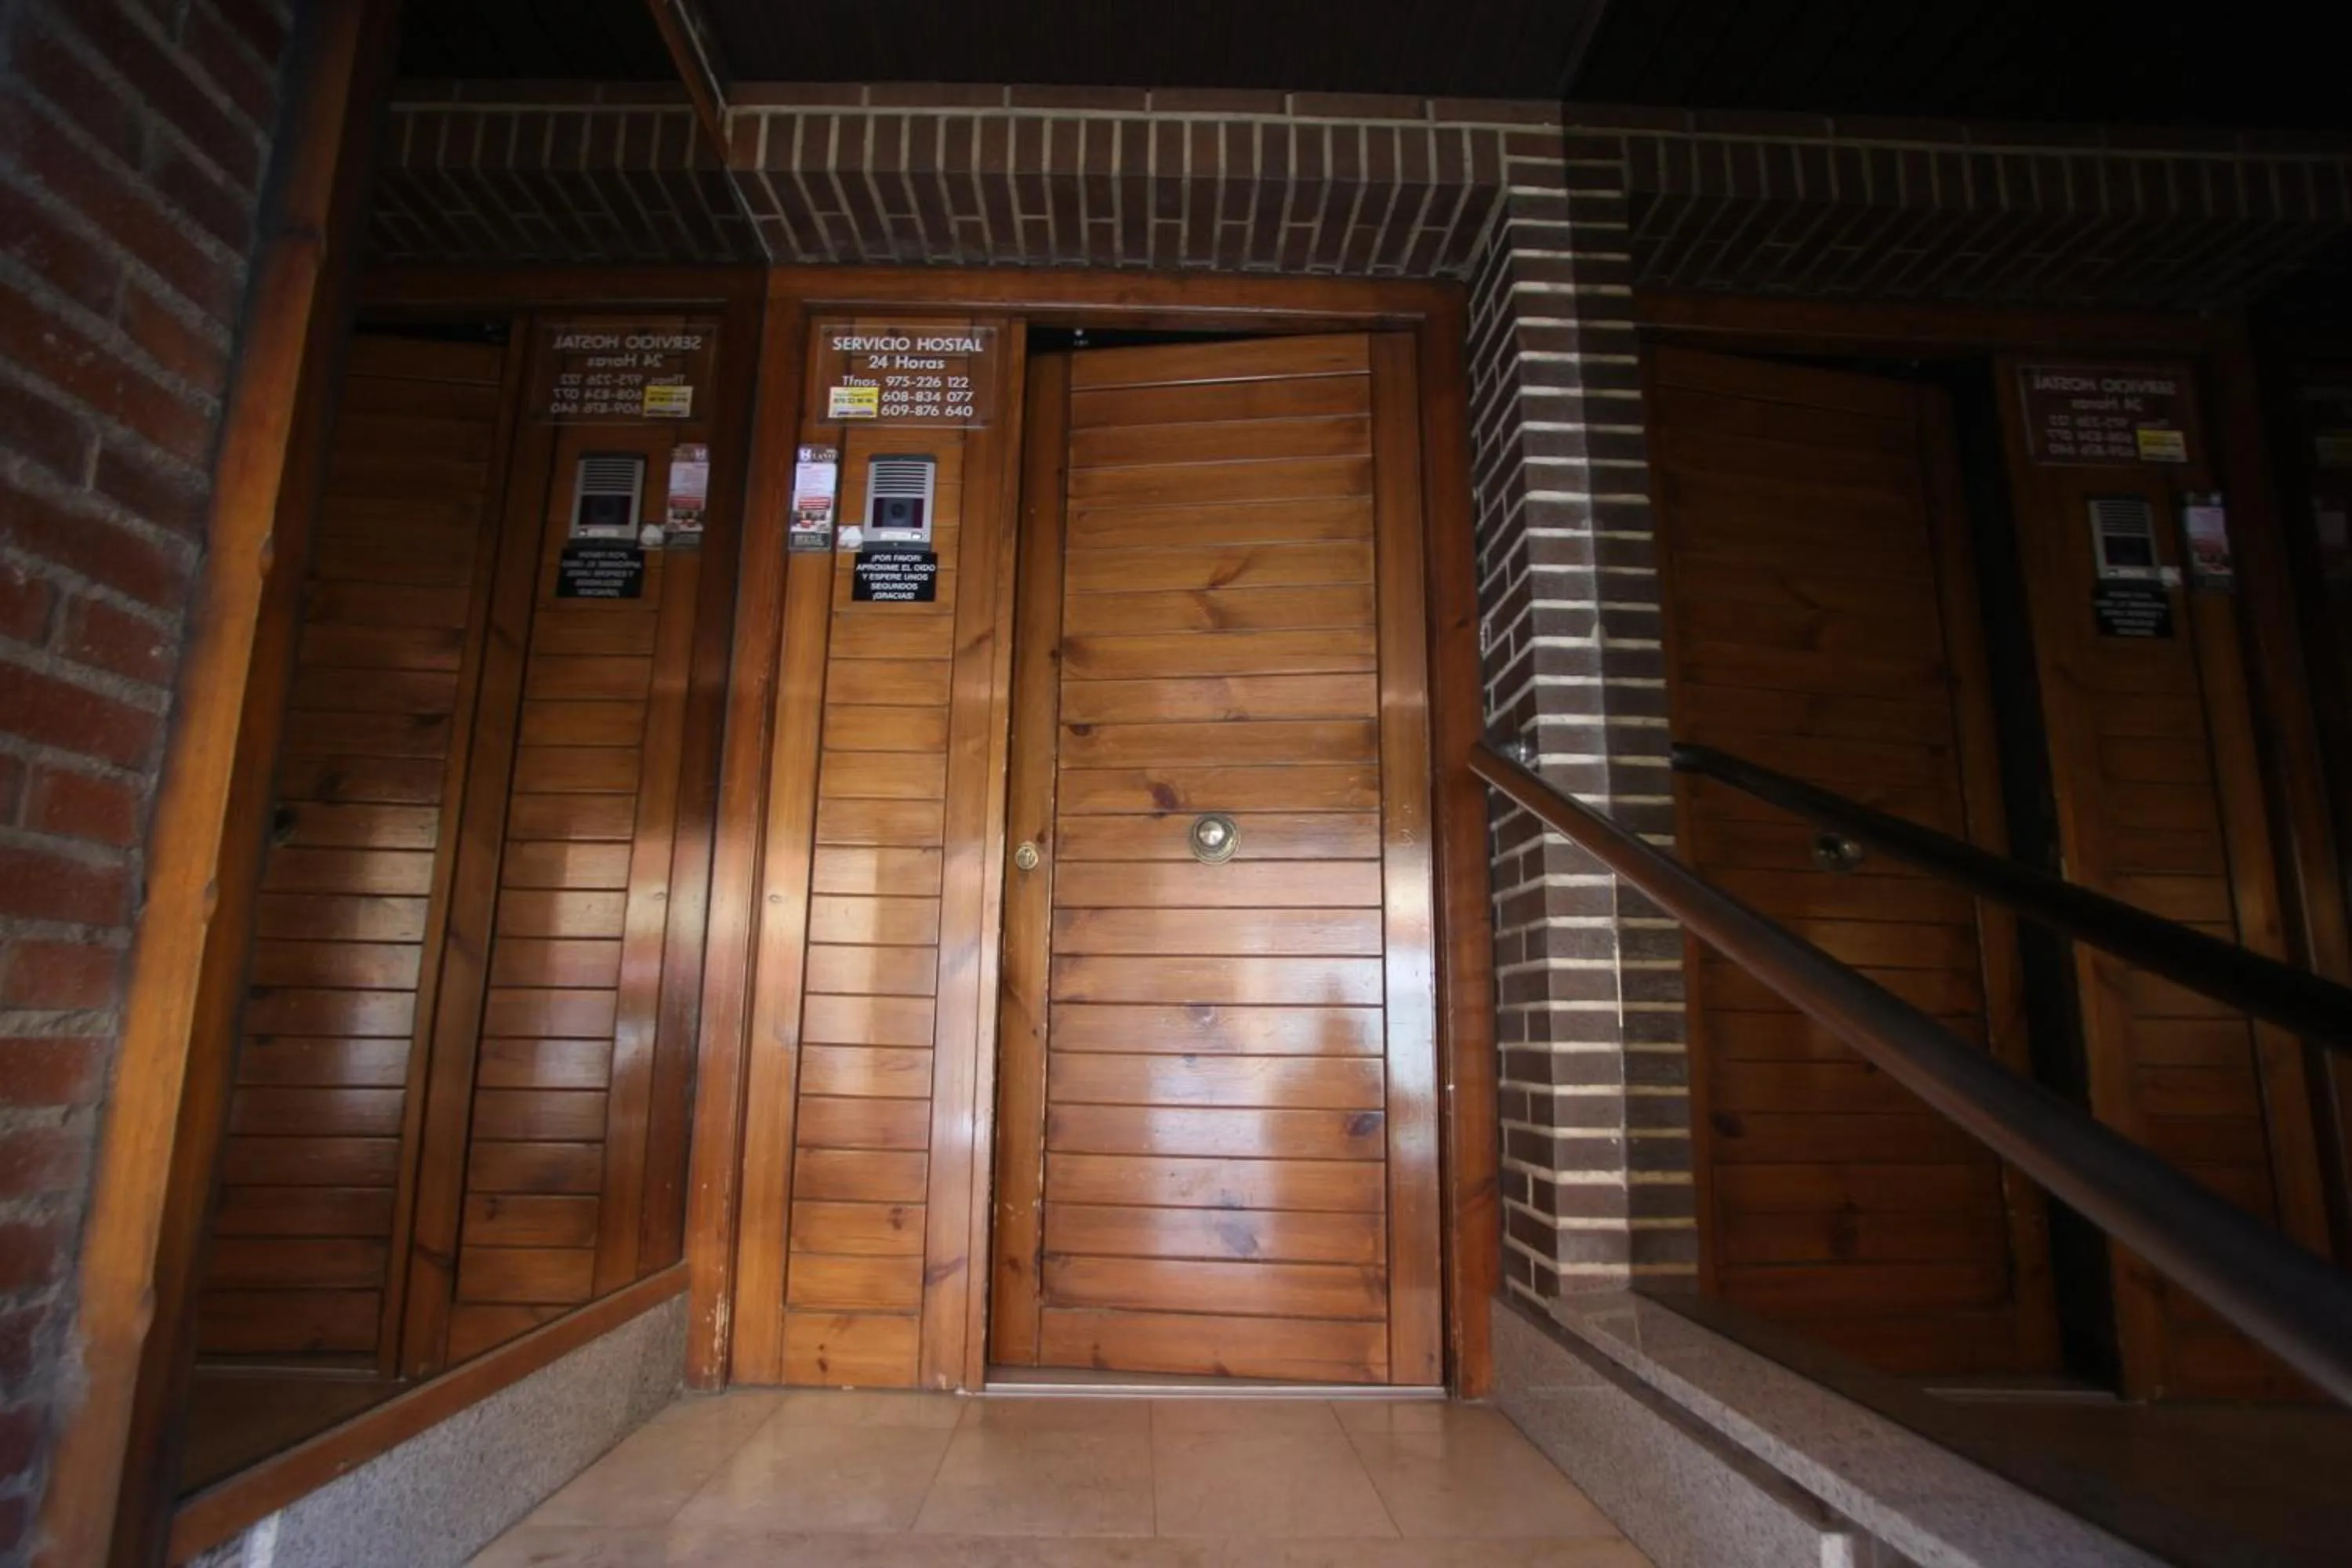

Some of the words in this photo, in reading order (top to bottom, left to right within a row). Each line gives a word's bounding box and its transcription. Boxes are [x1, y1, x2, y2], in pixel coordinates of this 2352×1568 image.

[832, 336, 910, 351] SERVICIO
[916, 338, 983, 352] HOSTAL
[868, 355, 887, 369] 24
[895, 355, 946, 369] Horas
[885, 376, 941, 387] 975-226
[947, 376, 969, 388] 122
[881, 390, 941, 403] 608-834
[946, 391, 974, 403] 077
[880, 405, 939, 416] 609-876
[945, 405, 974, 416] 640
